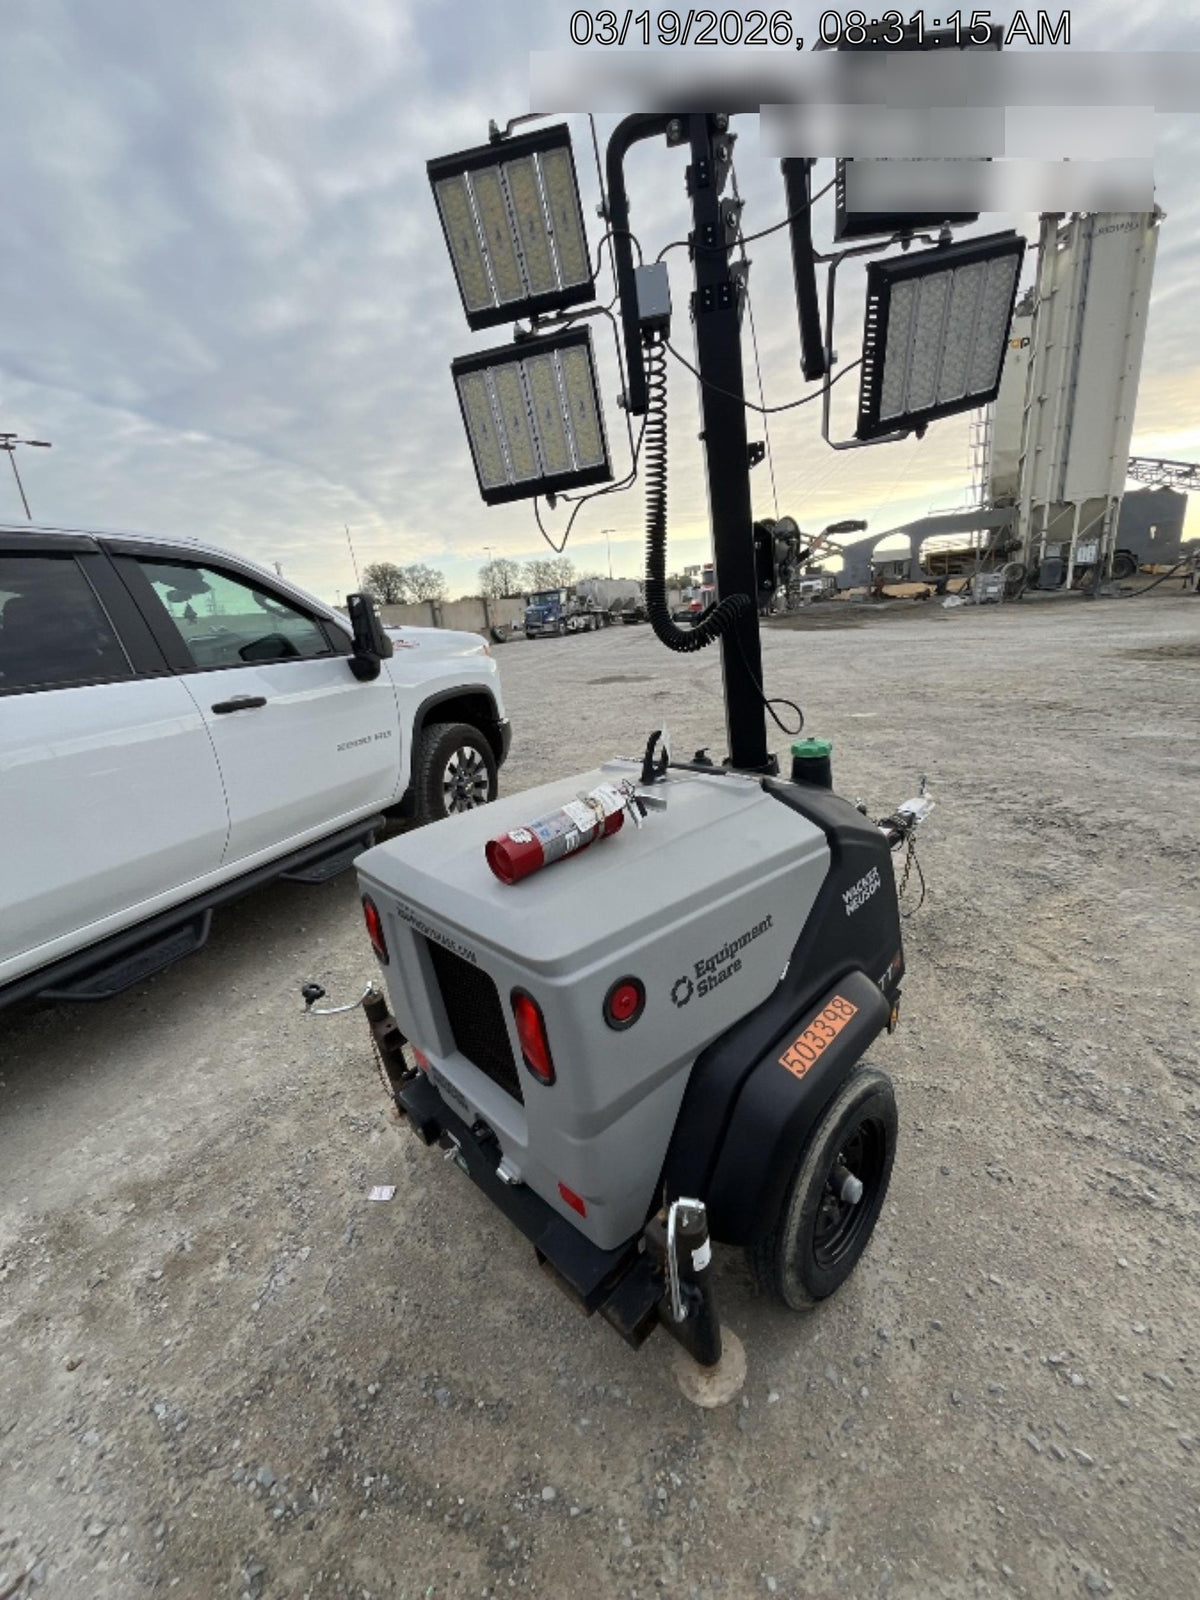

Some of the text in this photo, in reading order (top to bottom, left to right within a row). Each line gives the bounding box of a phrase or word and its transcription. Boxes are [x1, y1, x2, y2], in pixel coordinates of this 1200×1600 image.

[846, 878, 881, 916] NEUSON
[694, 914, 773, 979] Equipment
[697, 958, 742, 998] Share
[782, 998, 854, 1075] 503398
